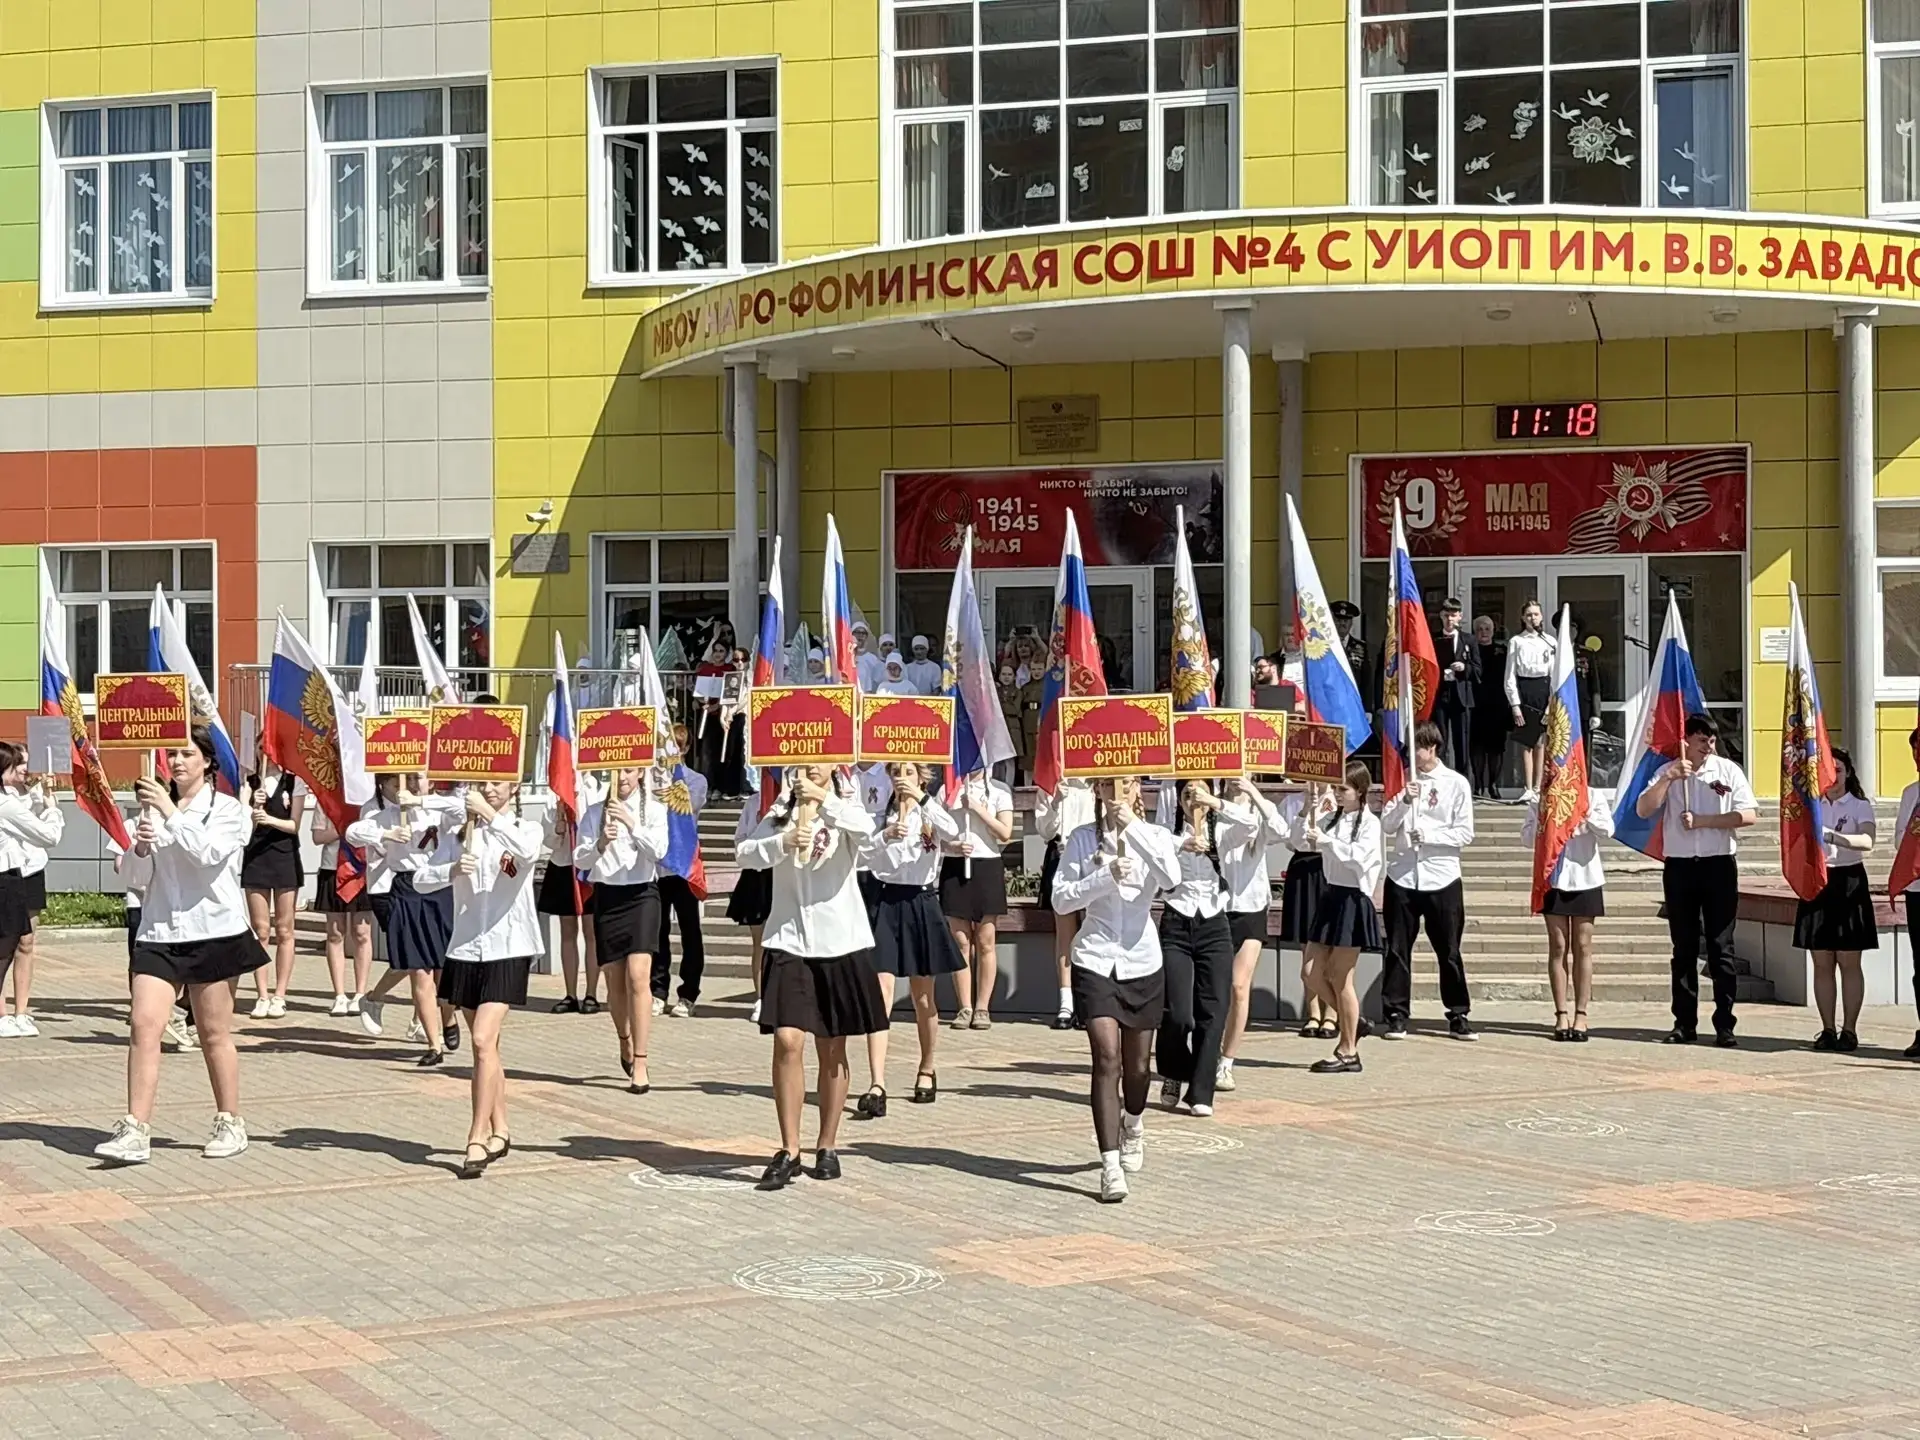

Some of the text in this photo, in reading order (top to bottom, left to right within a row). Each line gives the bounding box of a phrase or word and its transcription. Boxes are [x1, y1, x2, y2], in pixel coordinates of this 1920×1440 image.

[653, 306, 701, 358] МБОУ
[704, 248, 1059, 339] НАРО-ФОМИНСКАЯ
[1074, 235, 1195, 285] СОШ
[1212, 231, 1306, 277] №4
[1316, 229, 1353, 271] С
[1365, 228, 1532, 271] УИОП
[1549, 230, 1651, 273] ИМ.
[1510, 402, 1598, 437] 11:18
[1039, 479, 1076, 489] НИКТО
[1078, 479, 1093, 489] НЕ
[1083, 486, 1189, 498] НИЧТО НЕ ЗАБЫТО!
[1404, 477, 1436, 530] 9
[1485, 482, 1549, 513] МАЯ
[987, 514, 1039, 532] 1945
[1485, 514, 1551, 532] 1941-1945
[980, 537, 1022, 554] МАЯ
[99, 704, 186, 724] ЦЕНТРАЛЬНЫЙ
[121, 723, 163, 739] ФРОНТ
[771, 717, 834, 738] КУРСКИЙ
[872, 723, 941, 740] КРЫМСКИЙ
[366, 738, 427, 753] ПРИБАЛТИЙС
[436, 738, 514, 756] КАРЕЛЬСКИЙ
[579, 731, 654, 750] ВОРОНЕЖСКИЙ
[778, 738, 826, 755] ФРОНТ
[885, 739, 927, 754] ФРОНТ
[1065, 726, 1169, 751] ЮГО-ЗАПАДНЫЙ
[1174, 737, 1240, 756] АВКАЗСКИЙ
[385, 753, 422, 765] ФРОНТ
[598, 746, 634, 761] ФРОНТ
[1092, 749, 1142, 766] ФРОНТ
[452, 755, 495, 771] ФРОНТ
[1176, 755, 1218, 770] ФРОНТ
[1298, 760, 1327, 775] ФРОНТ
